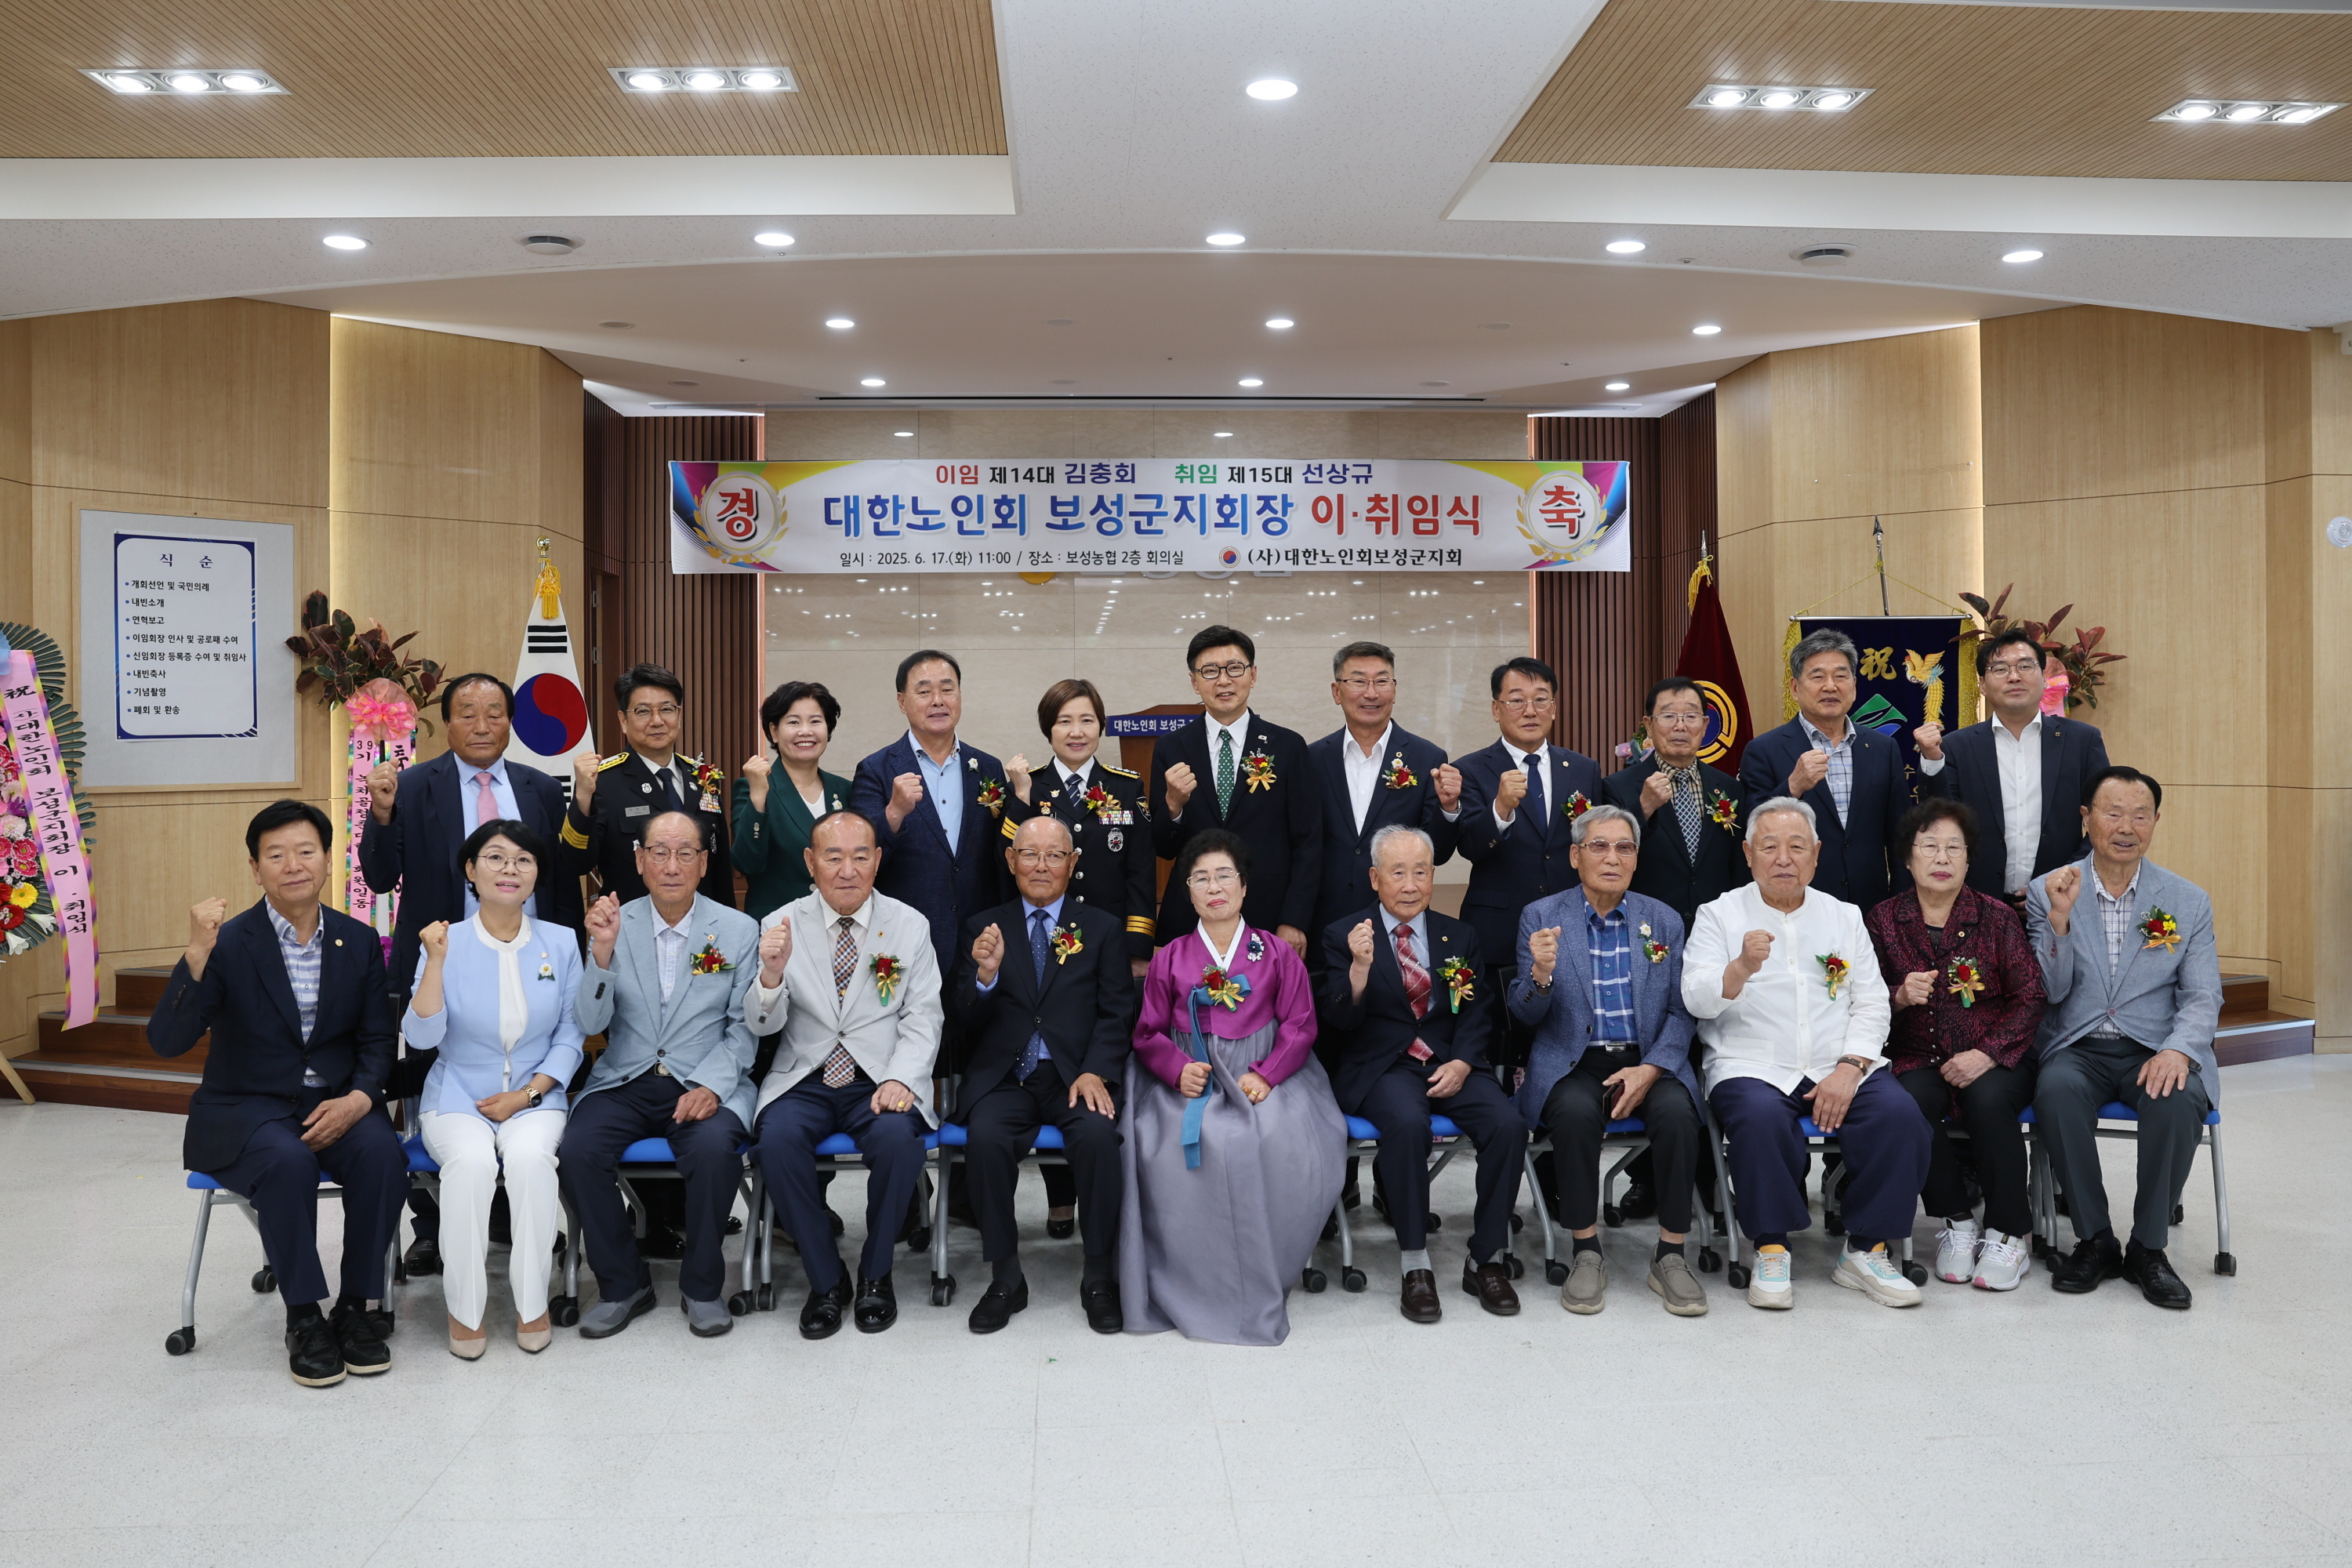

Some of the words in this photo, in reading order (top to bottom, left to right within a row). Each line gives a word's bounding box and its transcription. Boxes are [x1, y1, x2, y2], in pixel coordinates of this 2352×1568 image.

[936, 464, 978, 485] 이임
[989, 466, 1055, 485] 제14대
[1065, 462, 1136, 485] 김충회
[1174, 463, 1218, 485] 취임
[1227, 466, 1292, 485] 제15대
[1301, 463, 1374, 485] 선상규
[717, 487, 759, 539] 경
[824, 493, 1028, 537] 대한노인회
[1045, 492, 1295, 536] 보성군지회장
[1311, 493, 1480, 536] 이·취임식
[1537, 485, 1582, 539] 축
[159, 554, 173, 568] 식
[198, 555, 213, 569] 순
[840, 552, 864, 567] 일시
[877, 552, 911, 564] 2025.
[915, 552, 926, 564] 6.
[931, 551, 973, 566] 17.(화)
[978, 551, 1011, 564] 11:00
[1029, 550, 1054, 566] 장소
[1065, 550, 1117, 565] 보성농협
[1121, 550, 1142, 565] 2층
[1146, 550, 1184, 565] 회의실
[1247, 547, 1463, 568] (사)대한노인회보성군지회
[131, 579, 165, 590] 개회선언
[167, 581, 175, 590] 및
[177, 582, 209, 592] 국민의례
[132, 598, 165, 608] 내빈소개
[132, 615, 165, 625] 연혁보고
[132, 633, 165, 644] 이임회장
[168, 634, 184, 644] 인사
[187, 634, 194, 644] 및
[197, 635, 220, 644] 공로패
[223, 636, 238, 644] 수여
[132, 652, 165, 662] 신임회장
[168, 652, 192, 662] 등록증
[194, 652, 210, 662] 수여
[213, 653, 221, 662] 및
[223, 653, 247, 662] 취임사
[1860, 646, 1899, 681] 祝
[133, 670, 166, 679] 내빈축사
[4, 685, 37, 699] 祝
[133, 688, 166, 697] 기념촬영
[133, 706, 151, 715] 폐회
[153, 706, 162, 715] 및
[164, 706, 180, 715] 환송
[1114, 719, 1156, 732] 대한노인회
[34, 788, 75, 855] 보성군지회장
